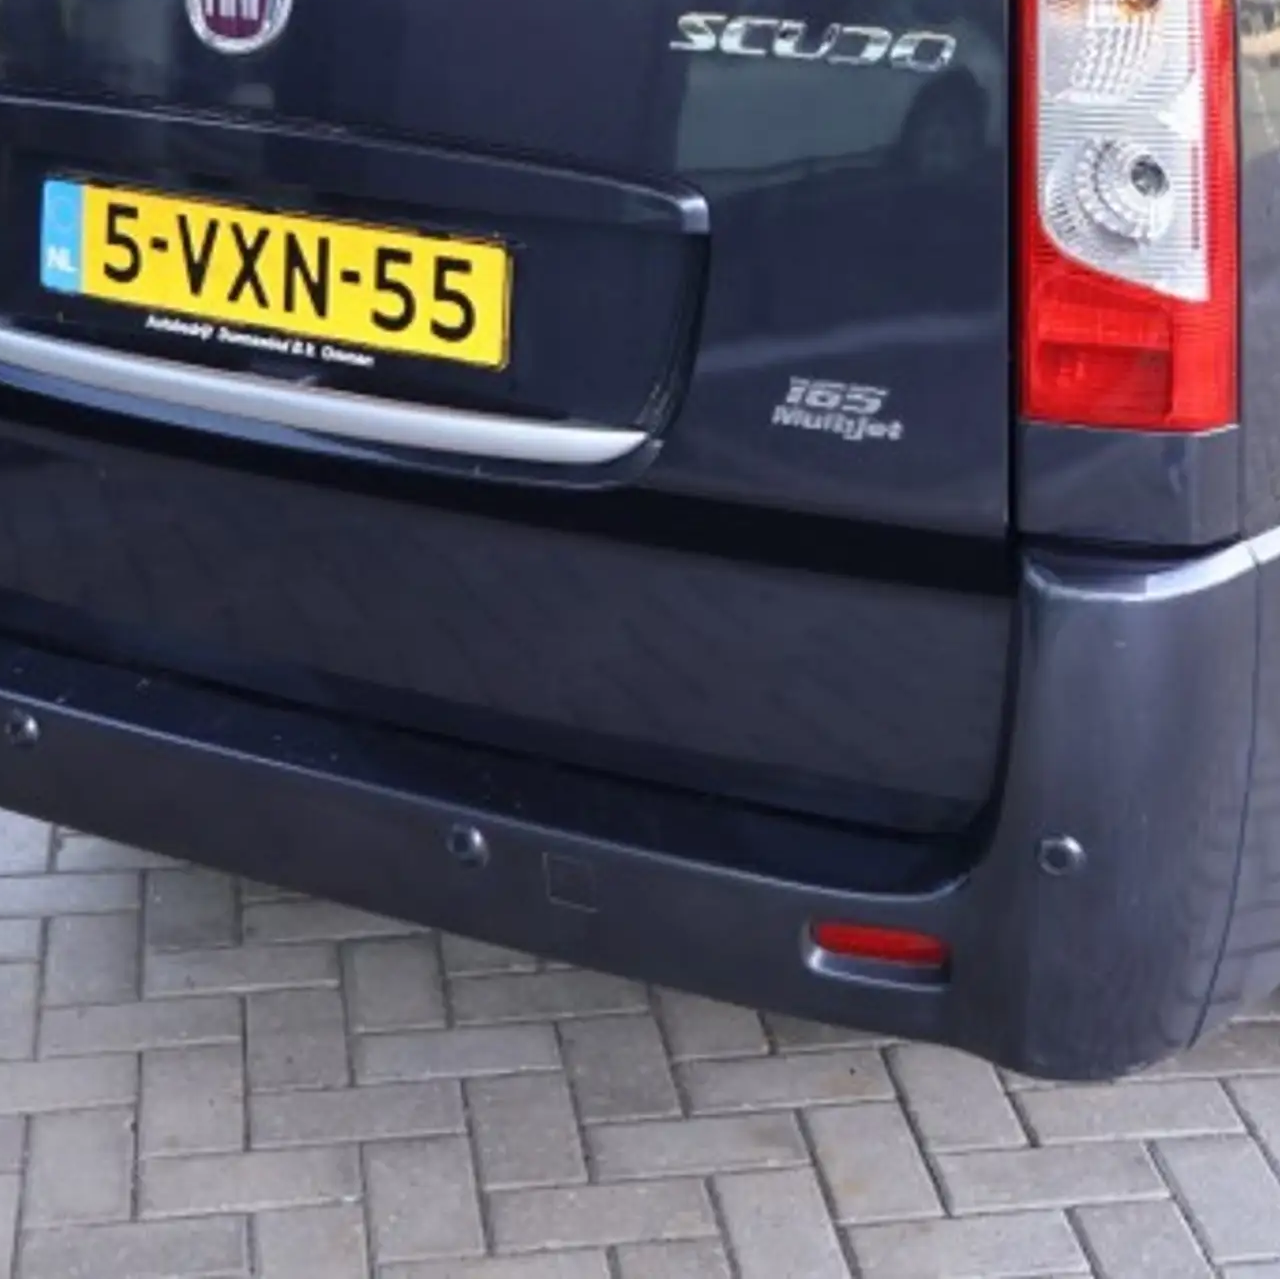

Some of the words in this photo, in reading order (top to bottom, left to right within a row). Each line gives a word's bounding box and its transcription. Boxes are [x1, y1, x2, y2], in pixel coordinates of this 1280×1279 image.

[669, 11, 957, 72] SCUDO
[47, 246, 77, 273] NL
[102, 202, 476, 343] 5-VXN-55
[786, 376, 890, 415] 165
